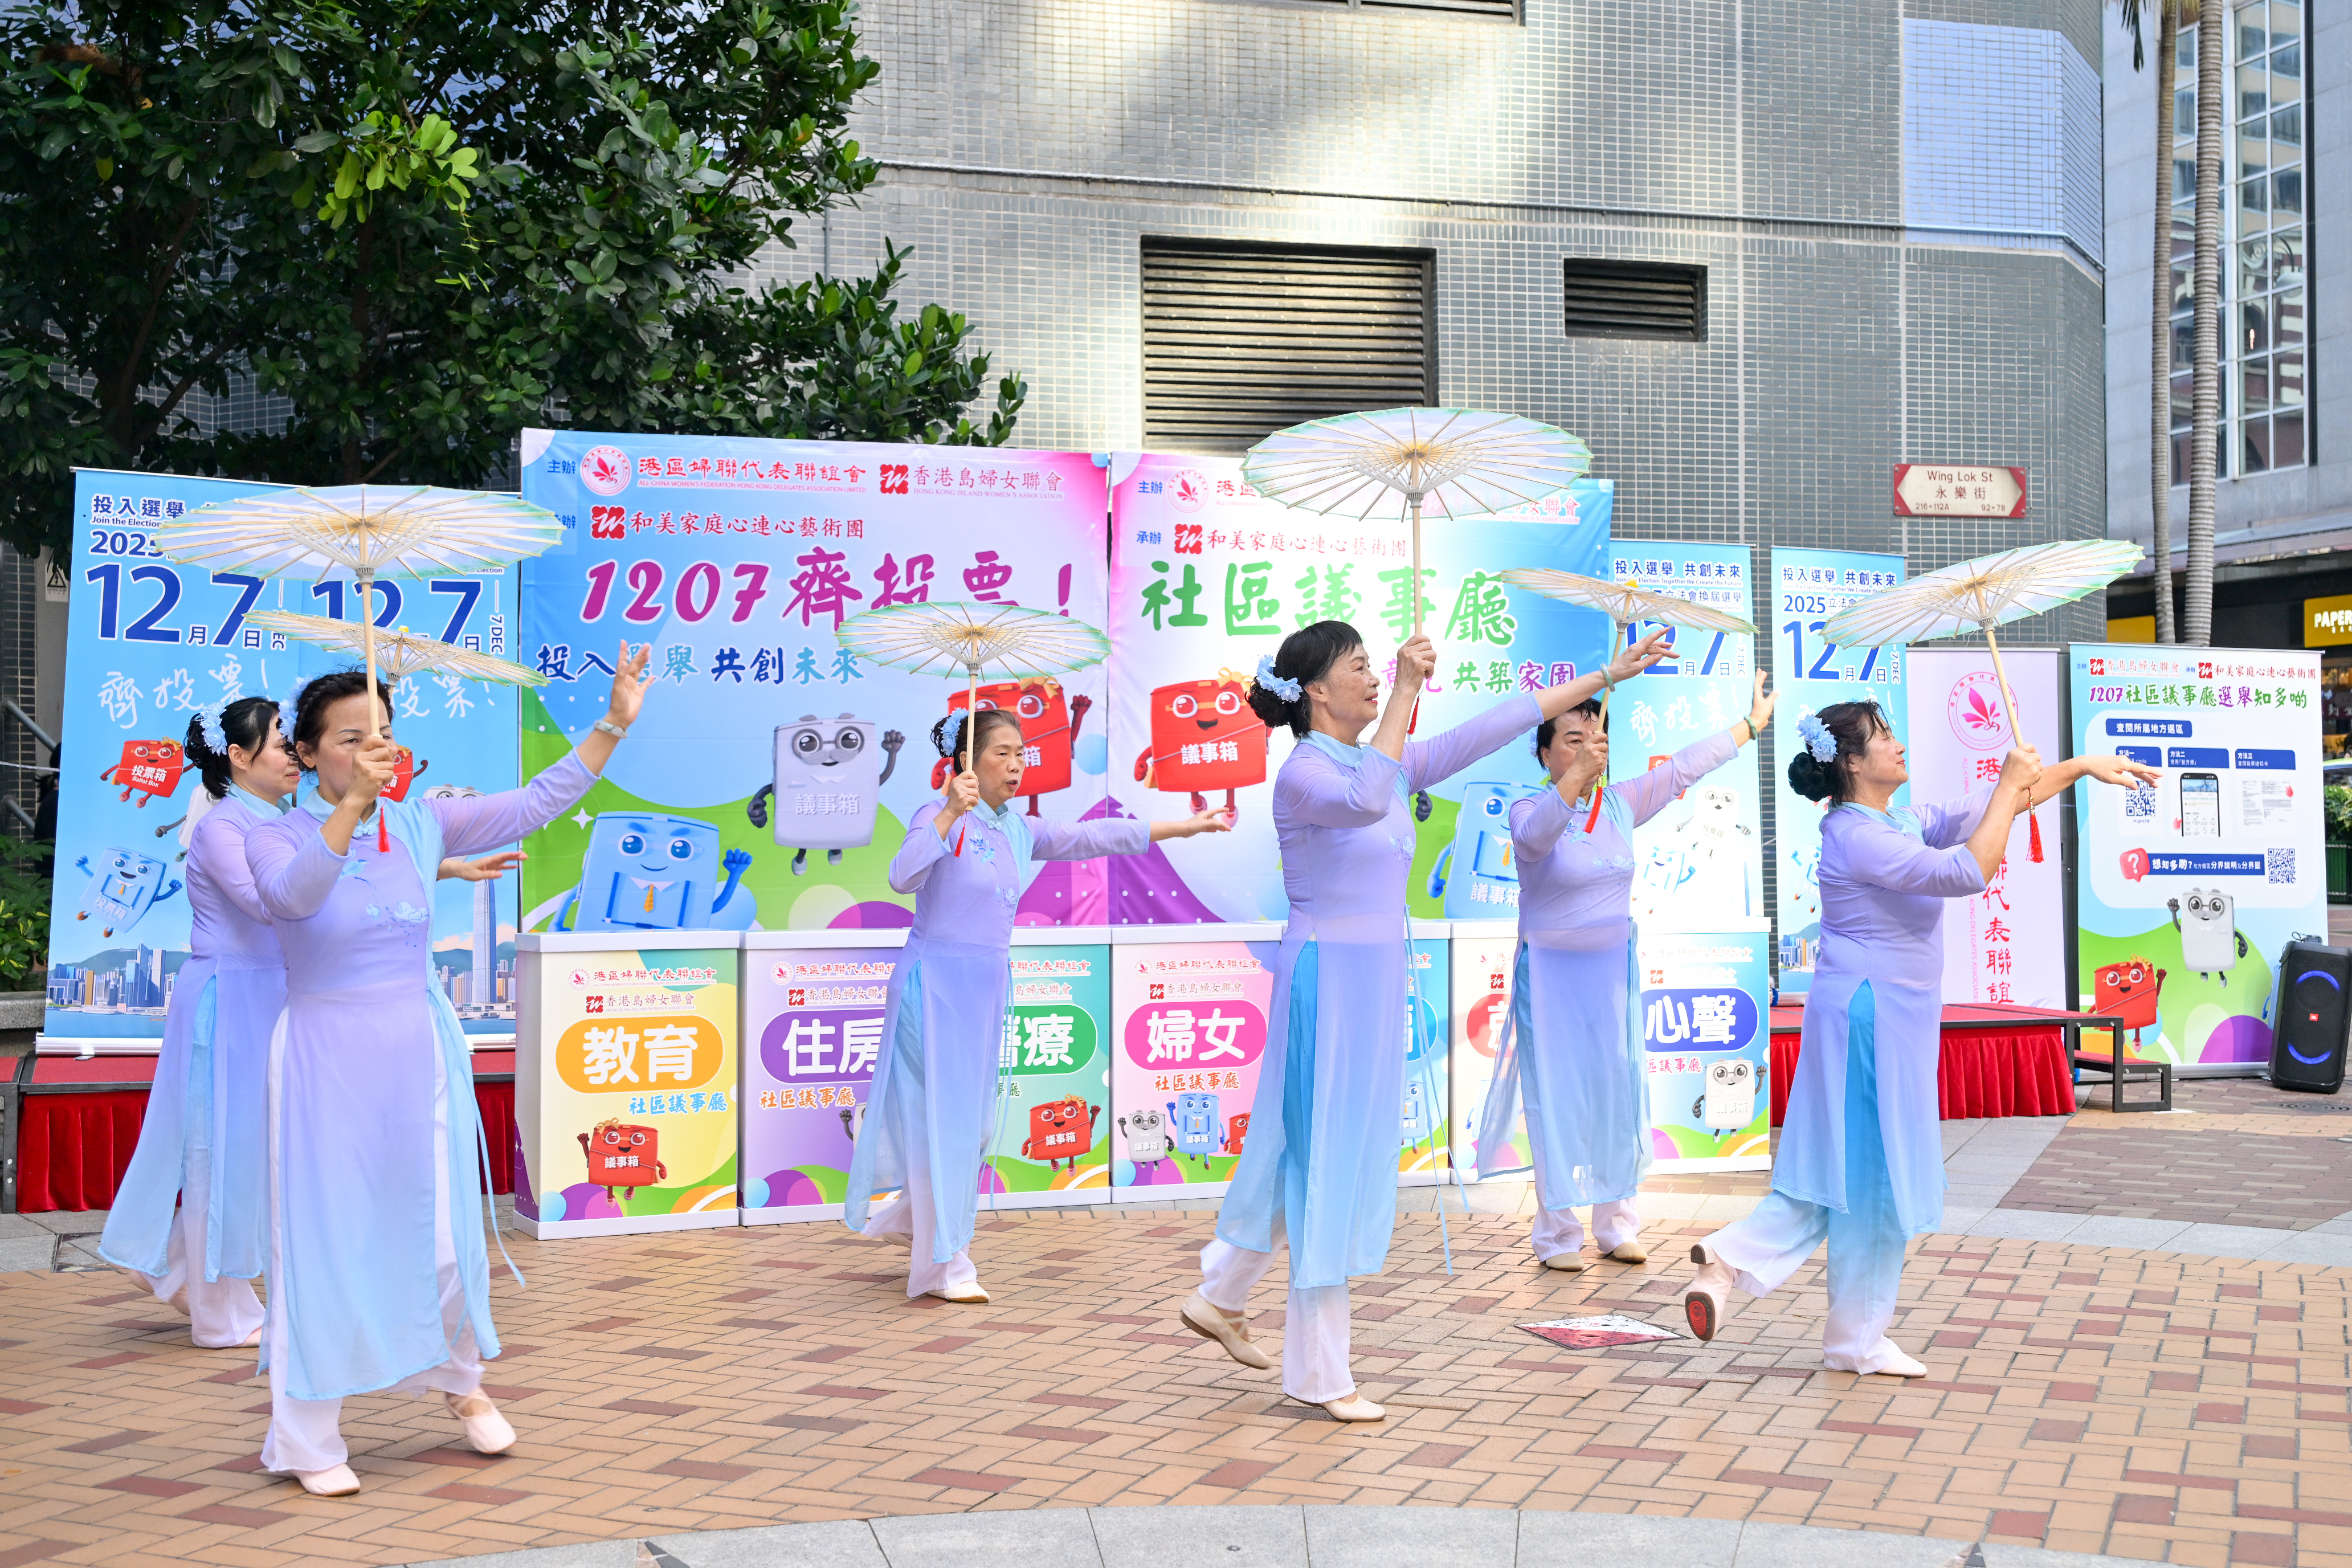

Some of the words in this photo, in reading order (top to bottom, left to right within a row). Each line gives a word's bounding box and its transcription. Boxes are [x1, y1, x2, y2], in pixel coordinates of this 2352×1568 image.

[548, 460, 575, 474] 主辦
[639, 458, 865, 483] 港區婦聯代表聯誼會
[913, 466, 1062, 492] 香港島婦女聯會
[1927, 471, 1953, 483] Wing
[1958, 471, 1976, 481] Lok
[1982, 472, 1993, 482] St
[1138, 481, 1163, 494] 主辦
[1935, 485, 1986, 500] 永樂街
[94, 496, 183, 518] 投入選舉
[92, 516, 111, 525] Join
[128, 518, 162, 527] Election
[630, 512, 863, 538] 和美家庭心連心藝術團
[1137, 531, 1161, 544] 承辦
[1207, 529, 1406, 557] 和美家庭心連心藝術團
[1615, 560, 1673, 575] 投入選舉
[1685, 563, 1740, 578] 共創未來
[1783, 567, 1835, 583] 投入選舉
[1845, 571, 1896, 586] 共創未來
[1141, 561, 1516, 646] 社區議事廳
[1784, 595, 1826, 614] 2025
[491, 627, 503, 654] DEC
[711, 646, 864, 685] 共創未來
[2106, 659, 2179, 673] 香港島婦女聯會
[2215, 665, 2316, 679] 和美家庭心連心藝術團
[1453, 661, 1577, 694] 共築家園
[2116, 722, 2183, 734] 查閱所屬地方選區
[1181, 741, 1238, 765] 議事箱
[132, 765, 168, 782] 投票箱
[132, 776, 148, 785] Ballot
[796, 793, 859, 815] 議事箱
[1471, 882, 1520, 907] 議事箱
[95, 896, 128, 920] 投票箱
[796, 963, 896, 975] 港區婦聯代表聯誼
[1156, 959, 1260, 970] 港區婦聯代表聯誼會
[594, 968, 716, 981] 港區婦聯代表聯誼會
[807, 987, 888, 1000] 香港島婦女聯會
[1009, 983, 1071, 995] 島婦女聯會
[1167, 981, 1242, 994] 香港島婦女聯會
[606, 993, 695, 1007] 香港島婦女聯會
[1644, 995, 1736, 1044] 心聲
[1147, 1008, 1246, 1063] 婦女
[583, 1024, 697, 1084] 教育
[782, 1017, 885, 1076] 住房
[1647, 1057, 1702, 1073] 區議事廳
[1155, 1072, 1239, 1092] 社區議事廳
[629, 1092, 727, 1114] 社區議事廳
[760, 1087, 855, 1108] 社區議事廳
[1045, 1132, 1076, 1146] 議事箱
[1134, 1142, 1159, 1152] 議事箱
[1186, 1135, 1209, 1144] 議事箱
[605, 1155, 639, 1168] 議事箱
